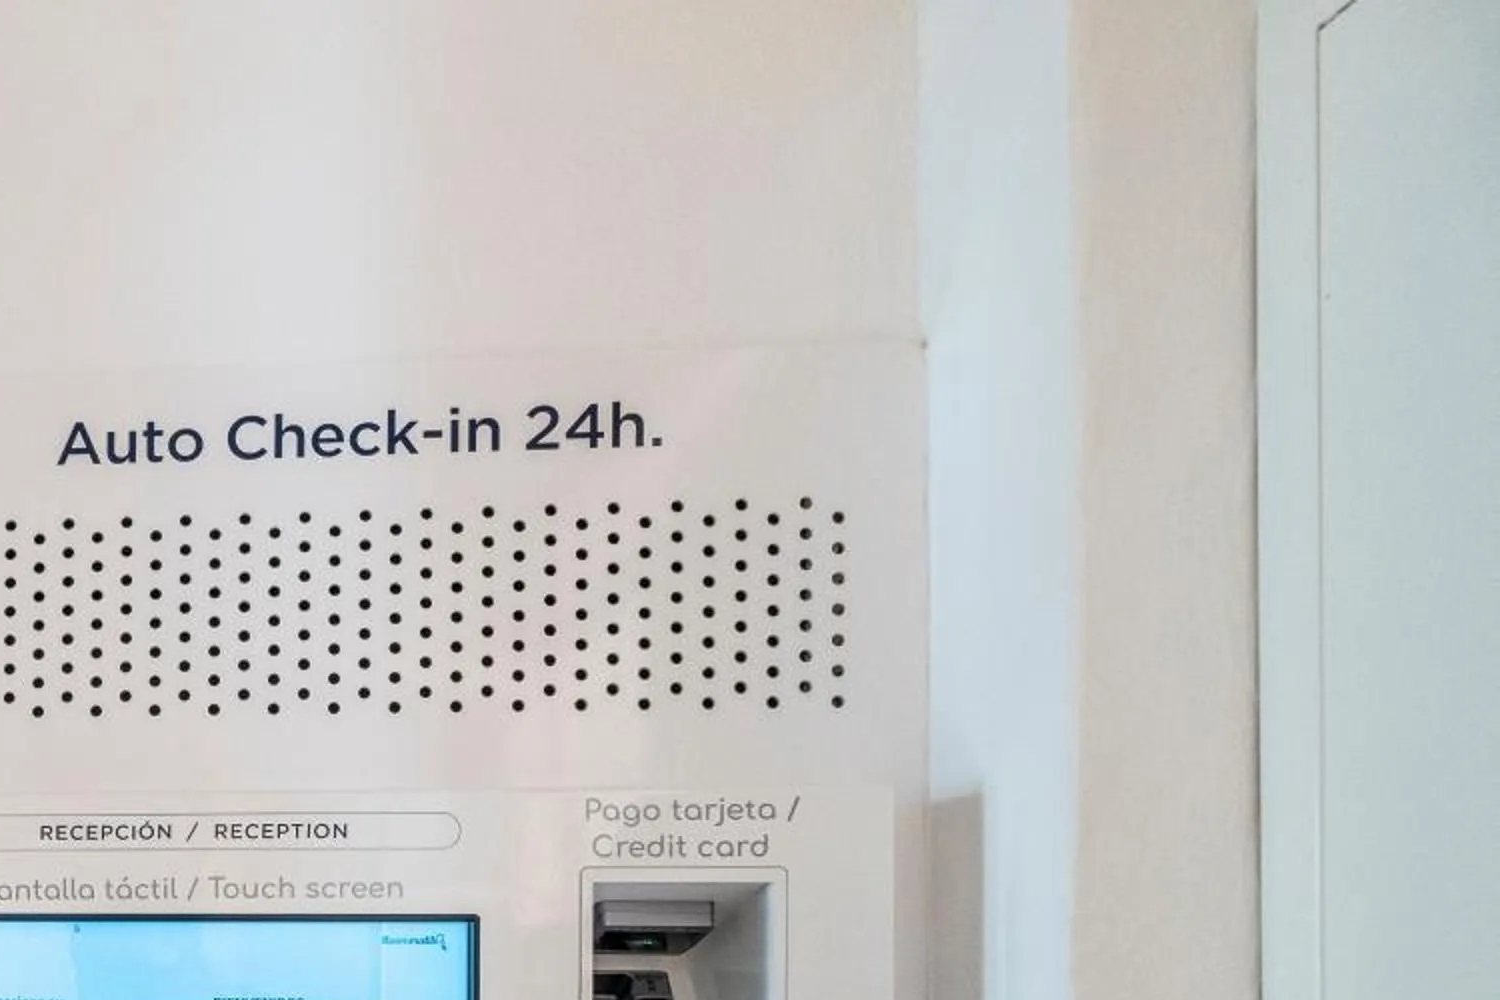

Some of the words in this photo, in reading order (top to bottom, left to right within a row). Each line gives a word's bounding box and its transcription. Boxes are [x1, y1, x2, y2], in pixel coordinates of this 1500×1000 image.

[56, 420, 205, 466] Auto
[227, 406, 501, 461] Check-in
[525, 400, 663, 451] 24h.
[585, 797, 662, 829] Pago
[672, 797, 777, 827] tarjeta
[787, 795, 801, 823] /
[39, 819, 172, 842] RECEPCIÓN
[185, 820, 199, 843] /
[213, 822, 348, 840] RECEPTION
[592, 833, 688, 859] Credit
[697, 833, 770, 858] card
[104, 875, 179, 901] táctil
[186, 875, 200, 903] /
[207, 875, 296, 900] Touch
[305, 881, 404, 900] screen
